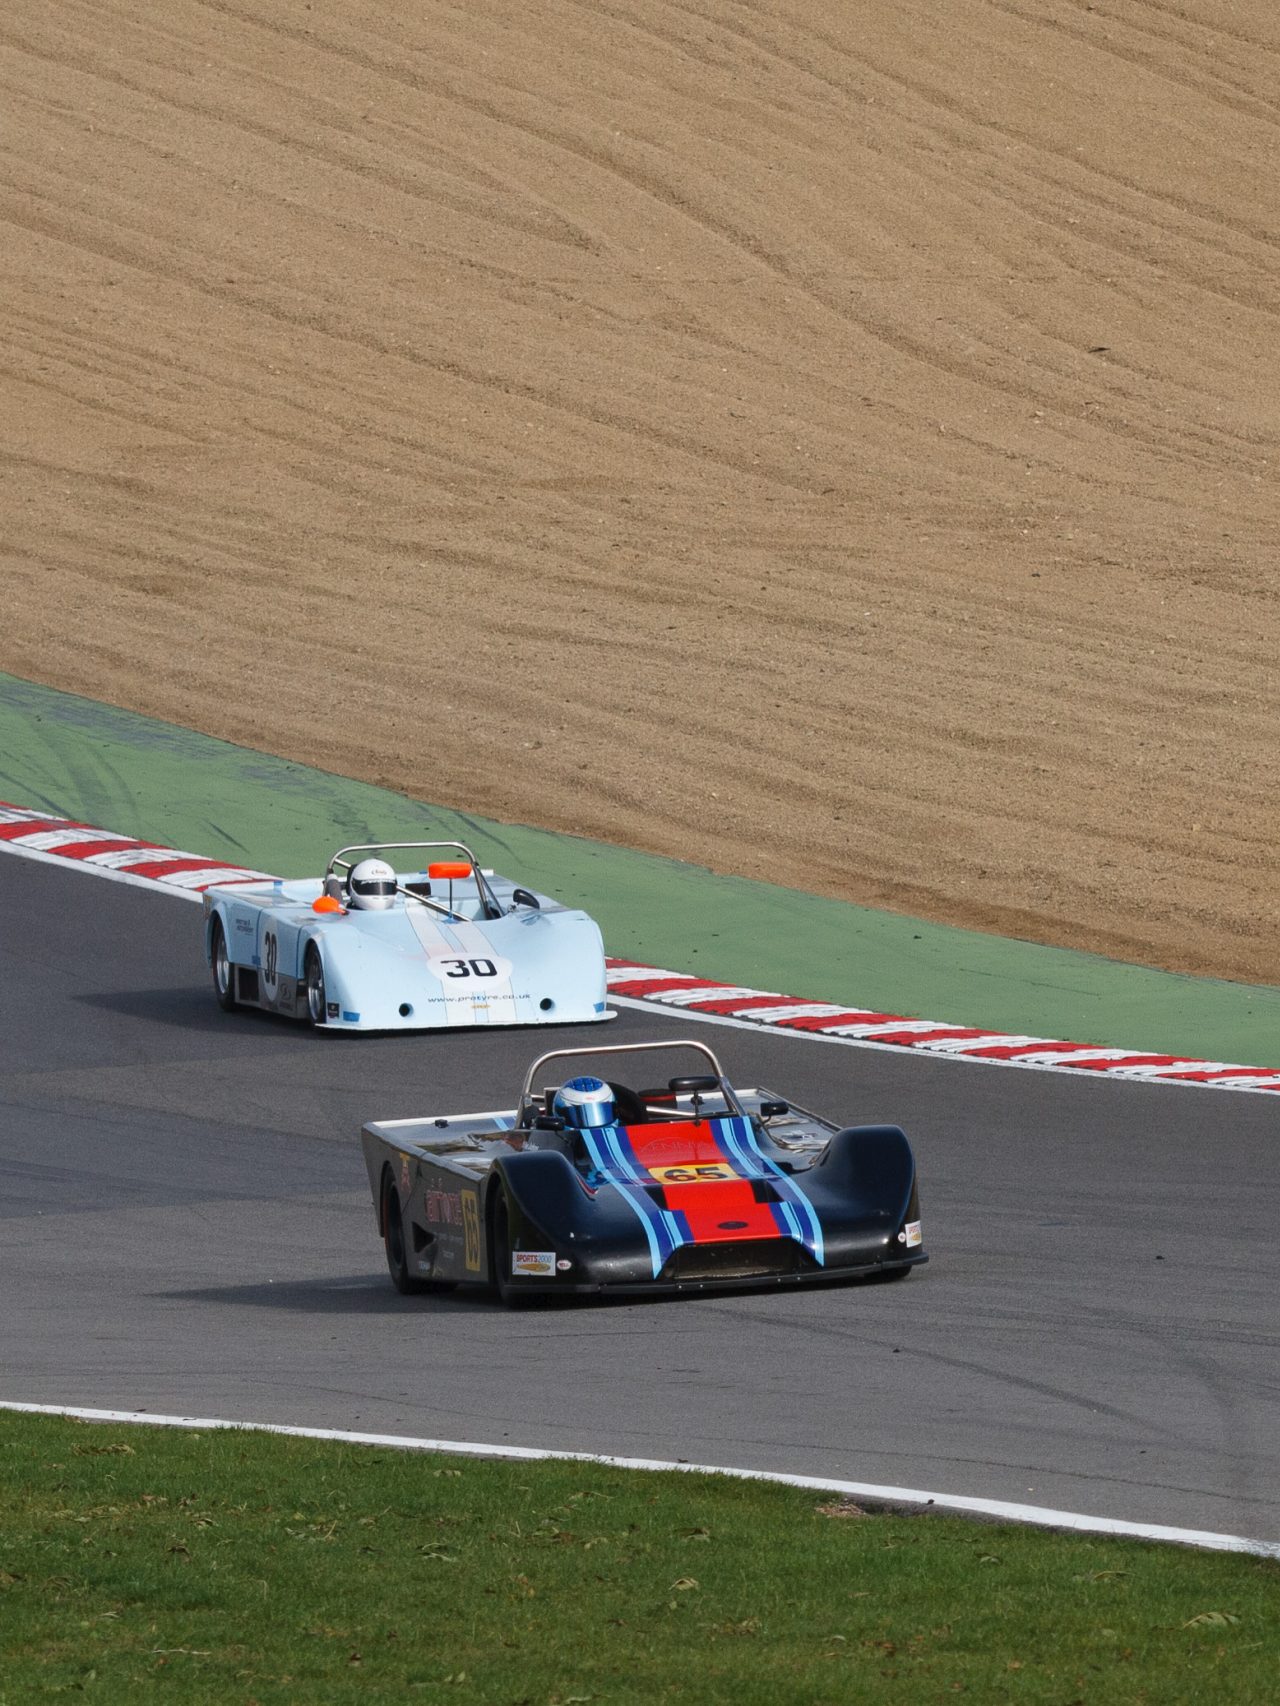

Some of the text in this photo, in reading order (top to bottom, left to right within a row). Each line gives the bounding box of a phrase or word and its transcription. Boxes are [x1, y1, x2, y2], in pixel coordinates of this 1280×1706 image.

[264, 931, 277, 986] 30
[440, 959, 498, 978] 30
[664, 1166, 729, 1182] 65
[463, 1197, 479, 1265] 65
